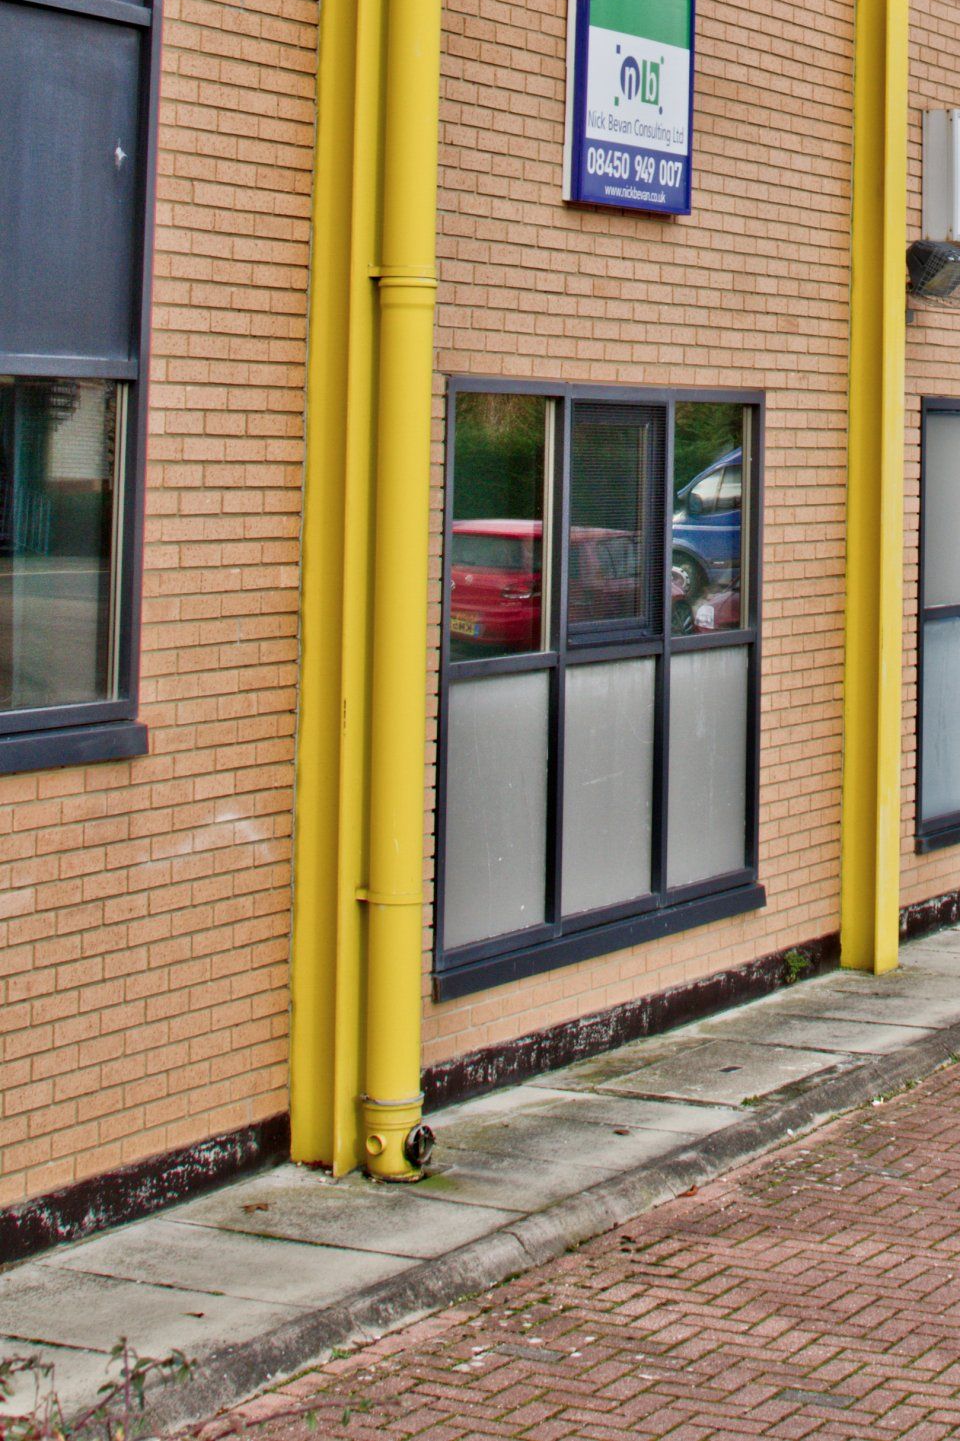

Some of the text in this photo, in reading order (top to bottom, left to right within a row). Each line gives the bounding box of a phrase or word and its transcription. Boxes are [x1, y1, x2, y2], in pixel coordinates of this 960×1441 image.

[587, 110, 685, 146] Nick Bevan Consulting Ltd
[587, 146, 683, 188] 08450 949 007
[604, 185, 666, 204] www.nickbevan.co.uk
